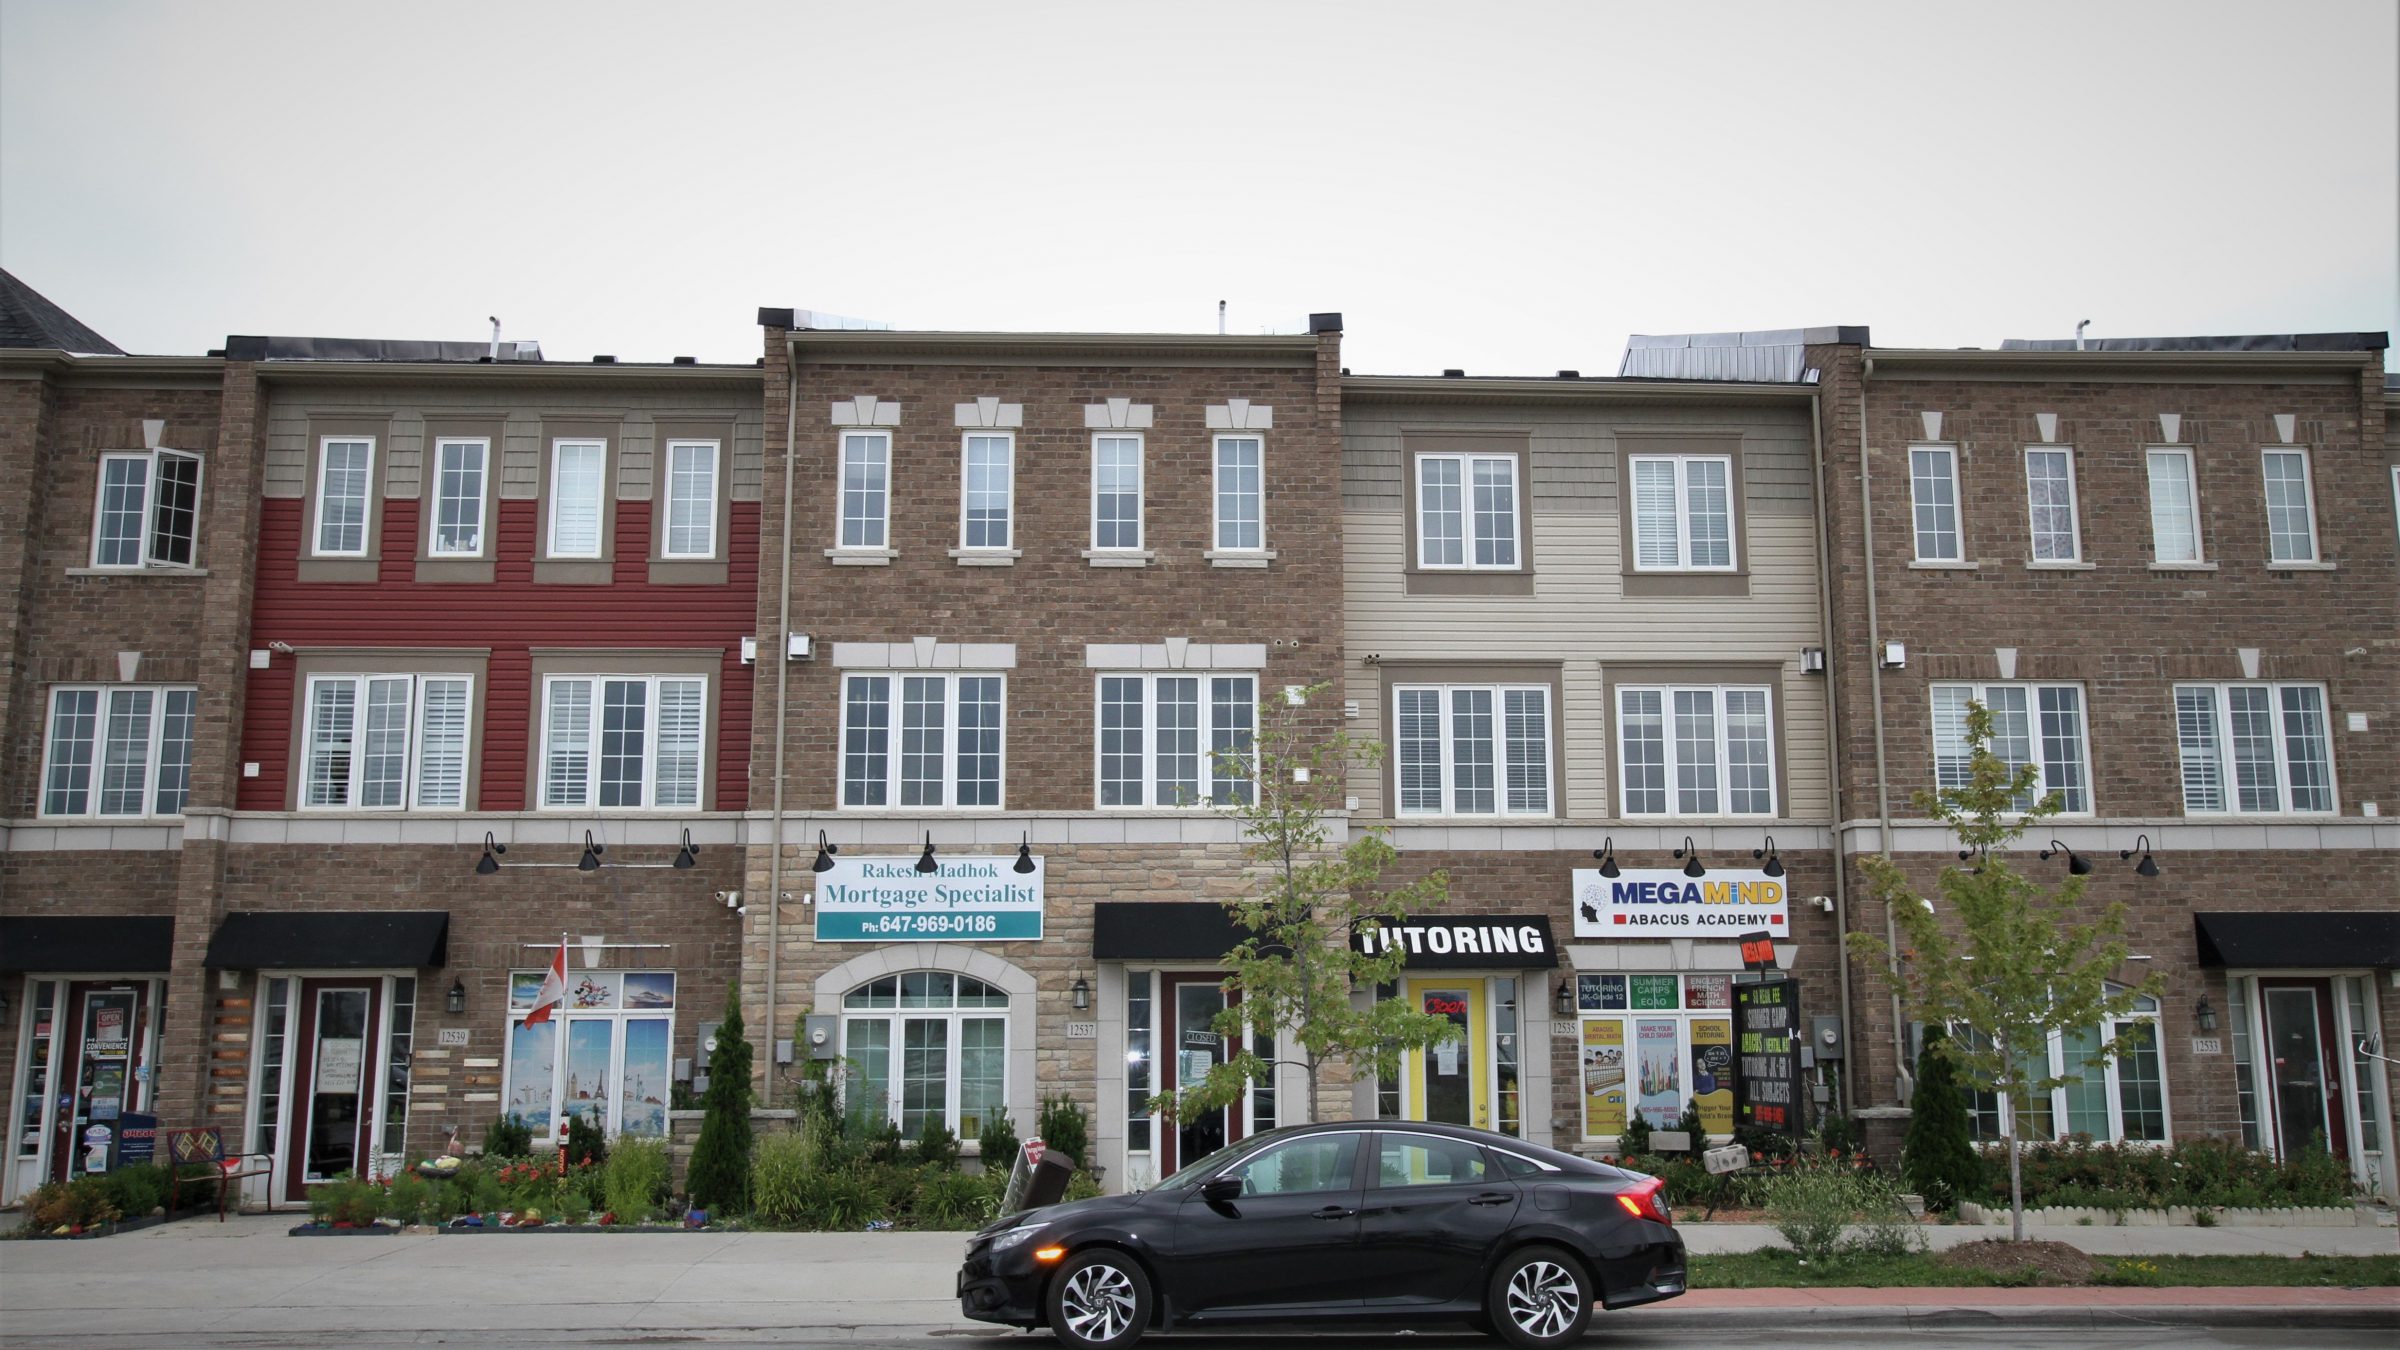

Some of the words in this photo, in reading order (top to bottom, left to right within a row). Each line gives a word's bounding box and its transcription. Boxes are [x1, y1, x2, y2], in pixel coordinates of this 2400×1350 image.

[825, 884, 928, 908] Mortgage
[935, 884, 1035, 908] Specialist
[862, 923, 878, 932] Ph:
[879, 915, 996, 932] 647-969-0186
[1629, 914, 1690, 925] ABACUS
[1696, 914, 1767, 925] ACADEMY
[1359, 926, 1545, 954] TUTORING
[1633, 978, 1674, 986] SUMMER
[1581, 984, 1624, 992] TUTORING
[1637, 986, 1670, 995] CAMPS
[1691, 984, 1725, 992] FRENCH
[1697, 991, 1720, 999] MATH
[1425, 998, 1467, 1014] Open
[1747, 1008, 1770, 1029] SUMMER
[1772, 1007, 1786, 1028] CAMP
[1070, 1025, 1093, 1036] 12537
[1553, 1022, 1575, 1034] 12535
[442, 1031, 466, 1043] 12539
[1187, 1033, 1216, 1043] CLOSED
[86, 1042, 127, 1050] CONVENIENCE
[2196, 1040, 2218, 1052] 12533
[1750, 1080, 1760, 1101] ALL
[1762, 1081, 1790, 1104] SUBJECTS
